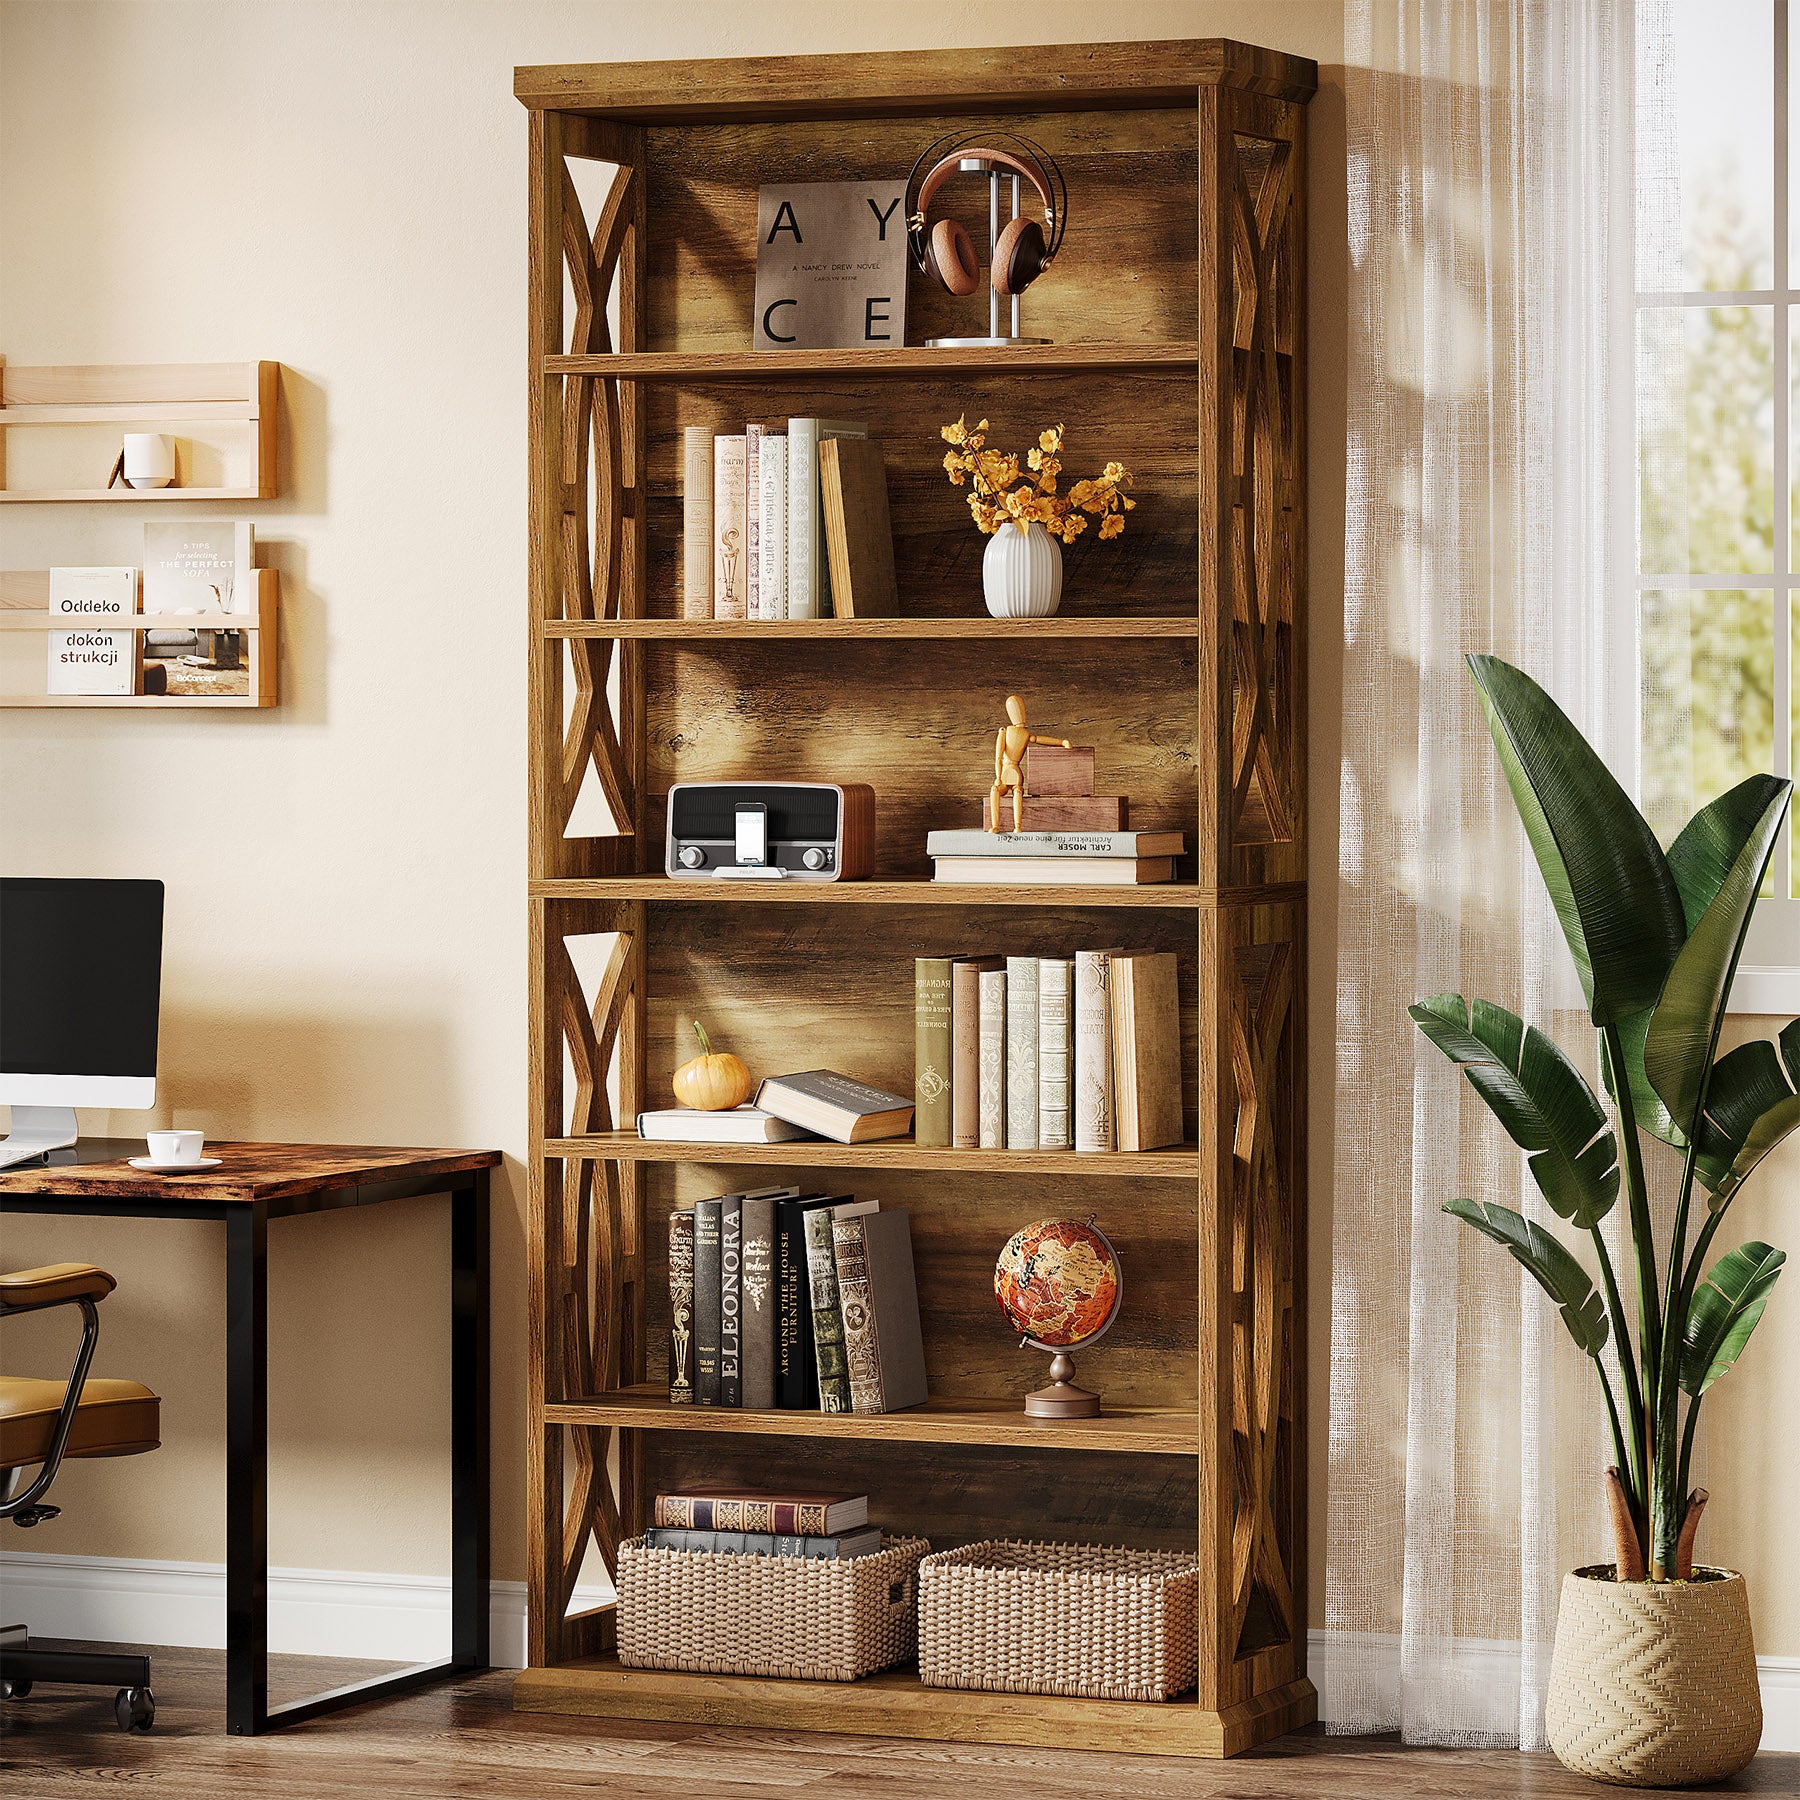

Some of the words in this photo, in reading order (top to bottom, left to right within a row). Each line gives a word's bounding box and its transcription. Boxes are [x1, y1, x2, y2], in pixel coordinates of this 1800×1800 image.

[766, 201, 804, 244] A
[866, 197, 902, 241] Y
[763, 299, 798, 343] C
[865, 297, 891, 341] E
[192, 542, 210, 550] TIPS
[175, 552, 186, 560] for
[187, 551, 218, 560] selecting
[160, 561, 181, 569] THE
[184, 560, 234, 568] PERFECT
[182, 569, 210, 577] SOFA
[60, 599, 121, 613] Oddeko
[60, 650, 118, 666] strukcji
[997, 835, 1013, 843] Zeit
[1035, 836, 1053, 844] eine
[1054, 836, 1066, 844] für
[1068, 836, 1113, 844] Architektur
[1058, 843, 1087, 851] MOSER
[781, 1232, 789, 1278] HOUSE
[722, 1209, 740, 1379] ELEONORA
[781, 1283, 789, 1312] THE
[789, 1264, 798, 1344] FURNITURE
[781, 1317, 789, 1376] AROUND
